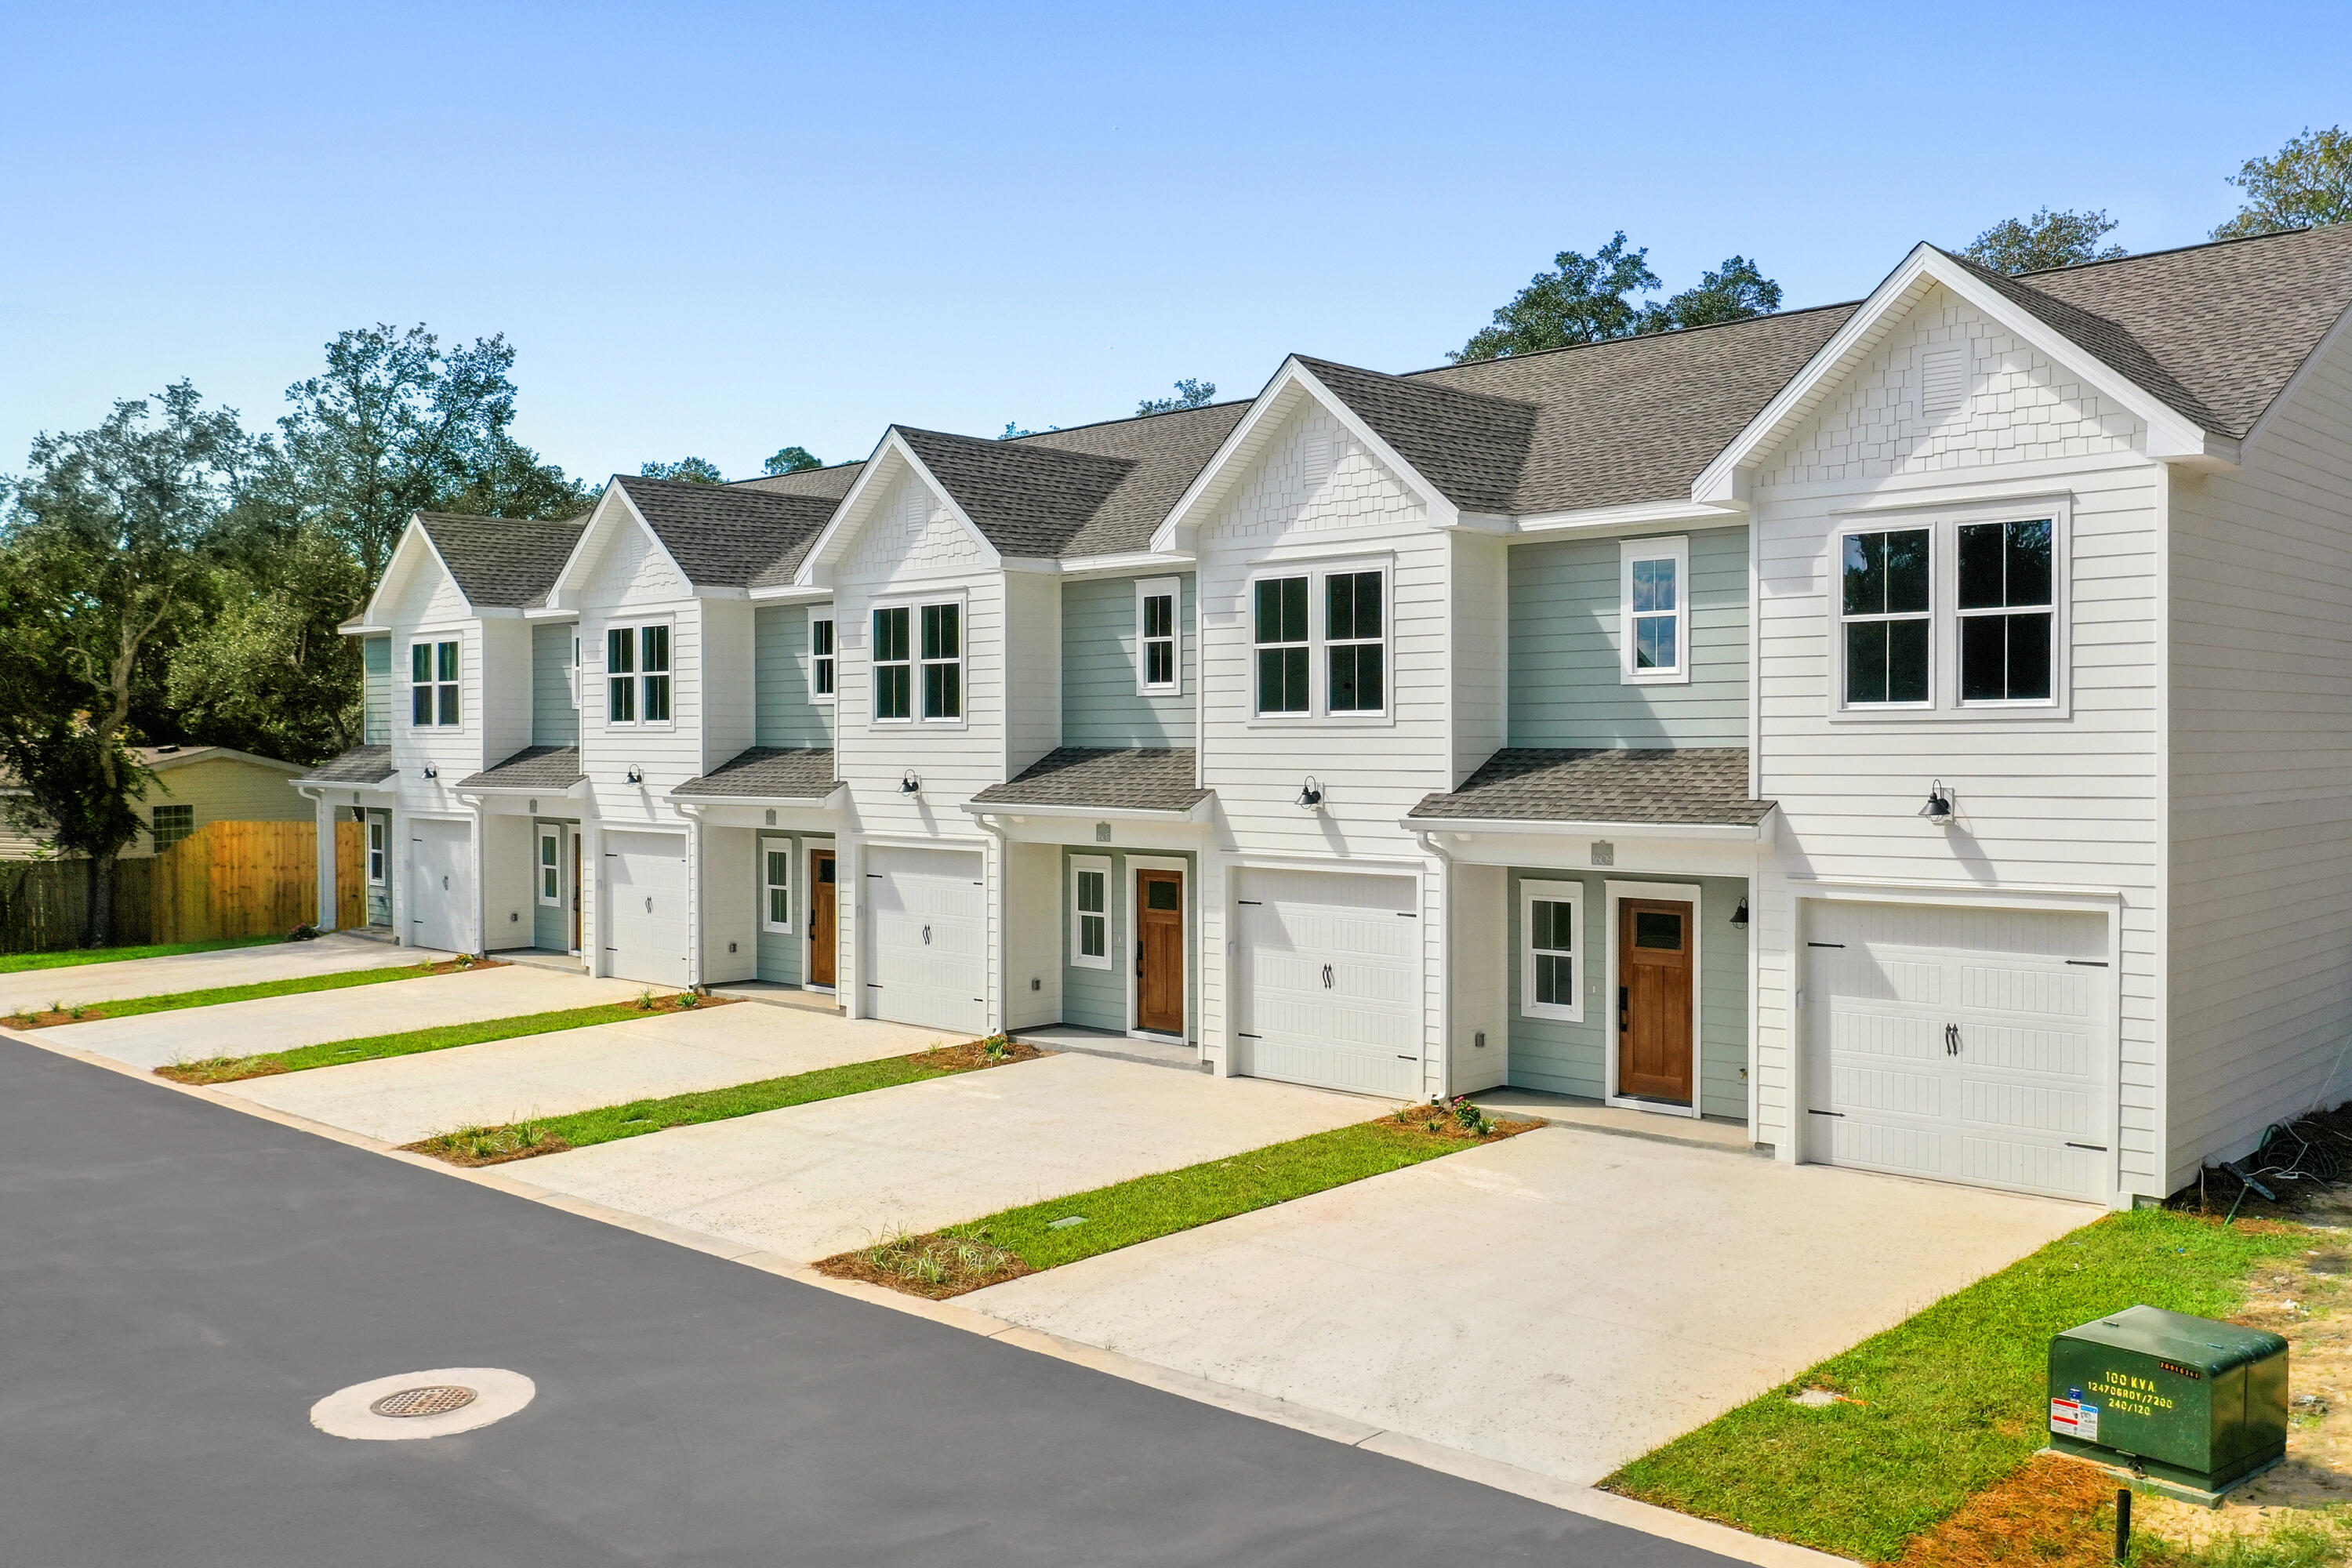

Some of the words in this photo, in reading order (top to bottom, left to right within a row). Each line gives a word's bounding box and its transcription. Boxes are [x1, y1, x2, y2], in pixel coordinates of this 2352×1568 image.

[1593, 854, 1613, 866] 1609
[2106, 1371, 2126, 1386] 100
[2131, 1377, 2154, 1392] KVA
[2088, 1381, 2172, 1409] 12470GRDY/7200
[2108, 1398, 2151, 1416] 240/120
